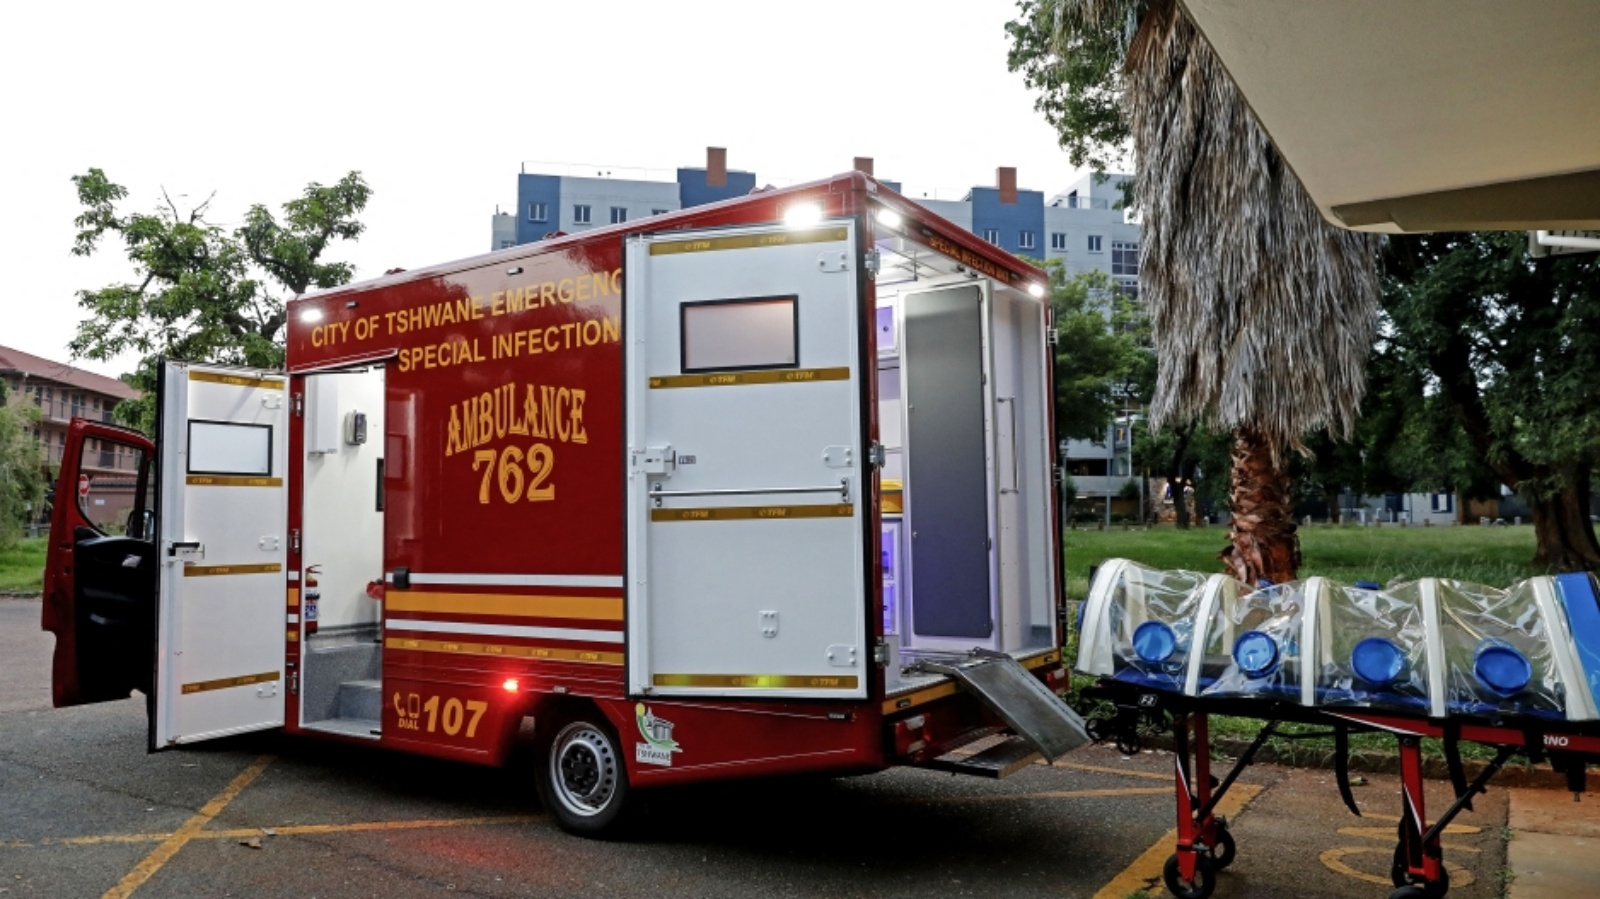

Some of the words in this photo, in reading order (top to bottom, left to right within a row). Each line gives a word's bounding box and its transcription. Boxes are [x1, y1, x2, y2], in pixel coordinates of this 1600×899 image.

[311, 320, 350, 348] CITY
[354, 315, 380, 340] OF
[384, 295, 484, 335] TSHWANE
[398, 337, 485, 373] SPECIAL
[491, 316, 621, 360] INFECTION
[445, 381, 588, 457] AMBULANCE
[472, 443, 555, 504] 762
[398, 717, 419, 731] DIAL
[423, 695, 489, 738] 107
